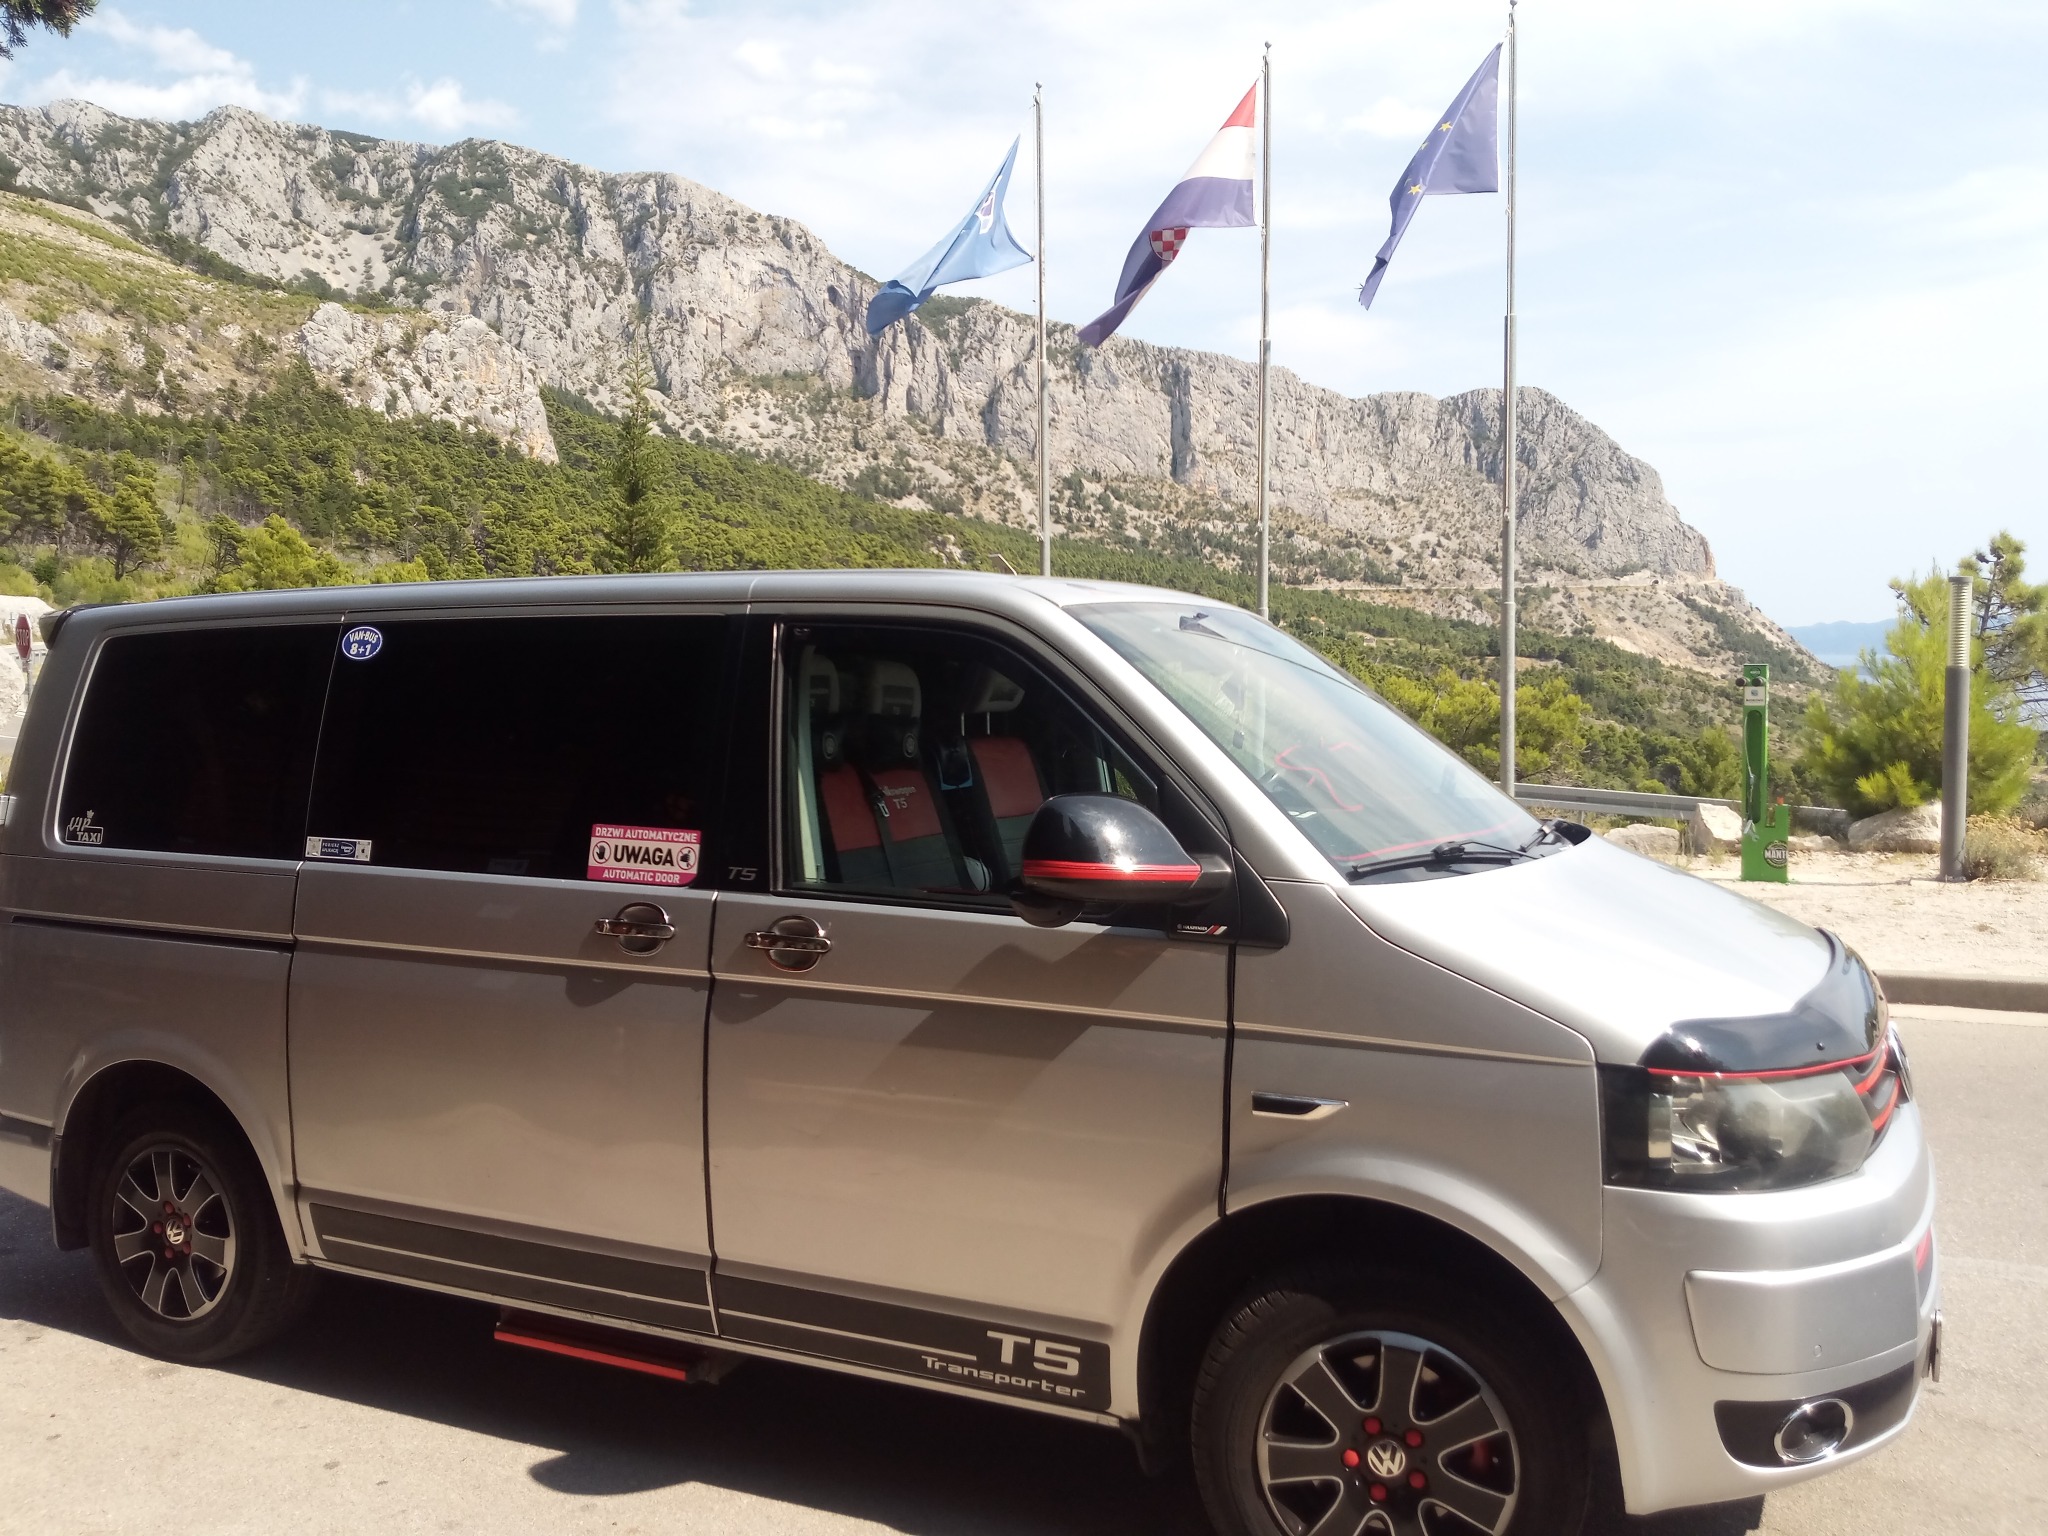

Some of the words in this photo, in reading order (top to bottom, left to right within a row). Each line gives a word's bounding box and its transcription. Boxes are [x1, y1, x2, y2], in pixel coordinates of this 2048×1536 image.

[16, 628, 30, 646] STOP
[350, 630, 378, 643] VAN-BUS
[350, 643, 371, 656] 8+1
[77, 832, 101, 842] TAXI
[595, 827, 624, 838] DRZWI
[625, 829, 697, 843] AUTOMATYCZNE
[613, 844, 674, 867] UWAGA
[603, 868, 653, 881] AUTOMATIC
[655, 873, 680, 883] DOOR
[728, 866, 758, 880] T5
[987, 1330, 1081, 1376] T5
[921, 1355, 1085, 1398] Transporter
